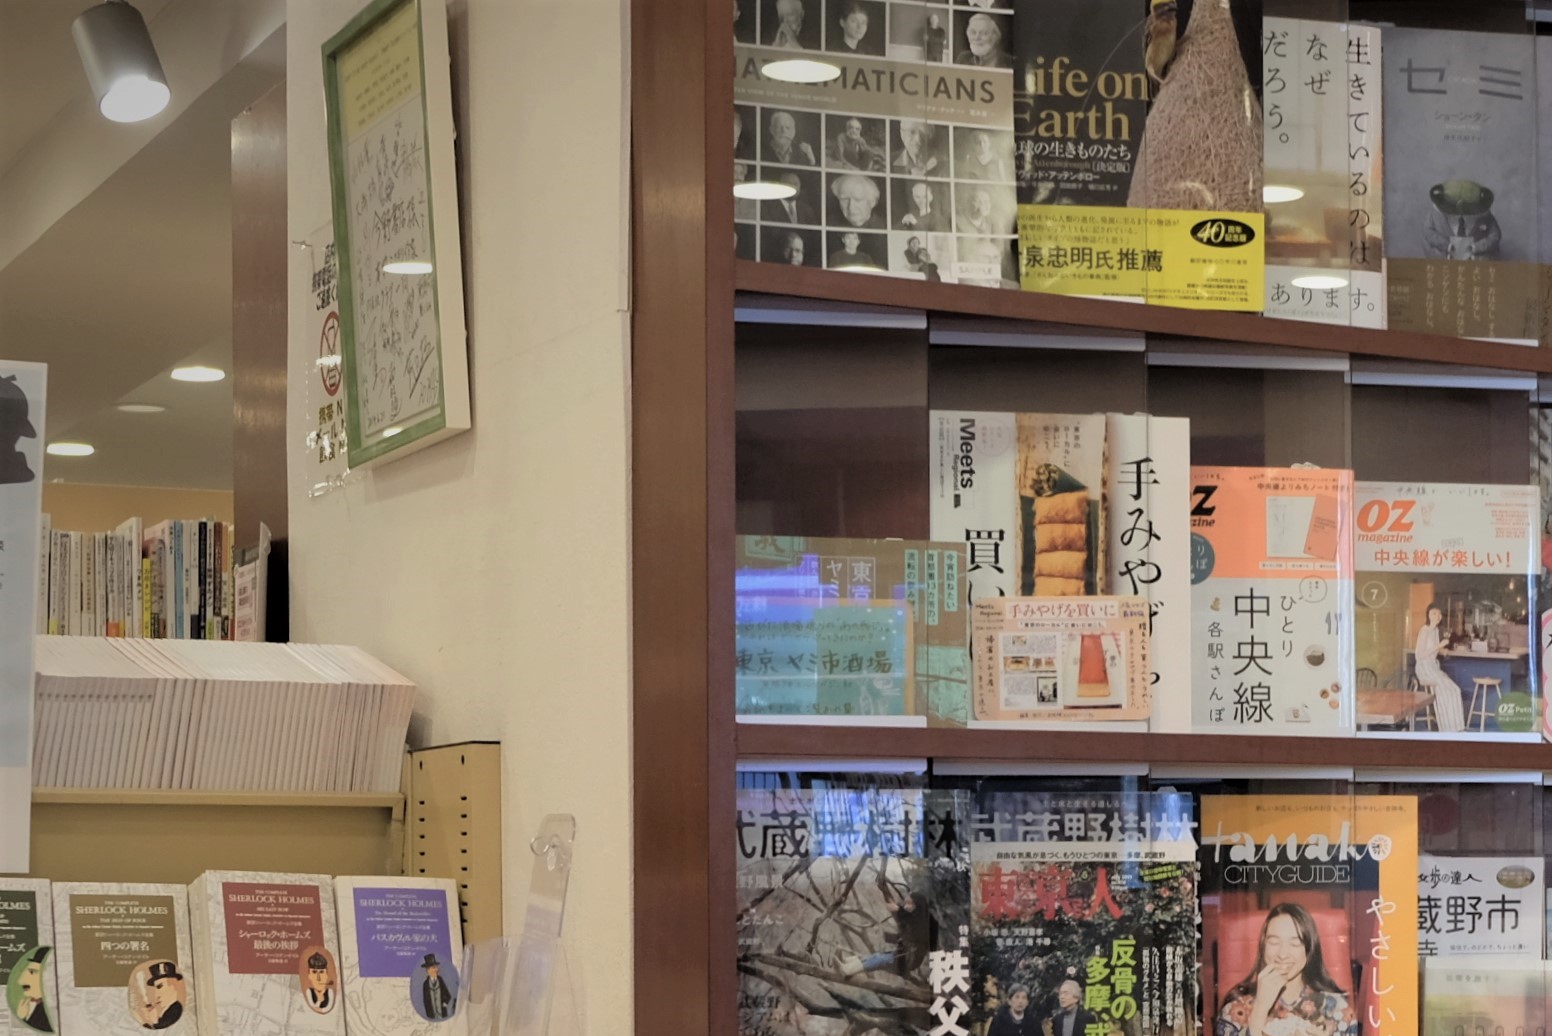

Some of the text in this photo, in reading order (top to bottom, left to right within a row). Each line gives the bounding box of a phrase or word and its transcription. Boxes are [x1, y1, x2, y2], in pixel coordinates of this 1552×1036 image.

[1304, 33, 1332, 96] なぜ
[1400, 57, 1523, 101] セミ
[735, 60, 996, 104] AEMATICIANS
[1097, 70, 1147, 100] on
[1264, 31, 1290, 144] だろう。
[1014, 102, 1132, 141] Earth
[1014, 141, 1132, 161] 球の生きものたち
[1345, 36, 1372, 265] 生きているのは
[1198, 222, 1225, 243] 40
[1018, 246, 1163, 273] 泉忠明氏推薦
[1271, 283, 1375, 312] あります。
[958, 417, 976, 490] Meets
[1356, 499, 1417, 533] OZ
[1357, 532, 1414, 545] magazine
[1374, 549, 1513, 569] 中央線が楽しい!
[1008, 603, 1117, 619] 手みやげを買いに
[1279, 594, 1297, 658] ひとり
[1232, 586, 1274, 725] 中央線
[1206, 620, 1225, 724] 各駅さんぽ
[228, 894, 315, 905] SHERLOCK HOLMES
[359, 898, 443, 909] SHERLOCK HOLMES
[979, 866, 1125, 922] 東京人
[75, 906, 168, 915] SHERLOCK HOLMES
[100, 940, 151, 952] 四つの署名
[238, 929, 312, 941] シャーロック・ホームズ
[253, 939, 300, 951] 最後の挨拶
[1109, 937, 1139, 1021] 反骨の
